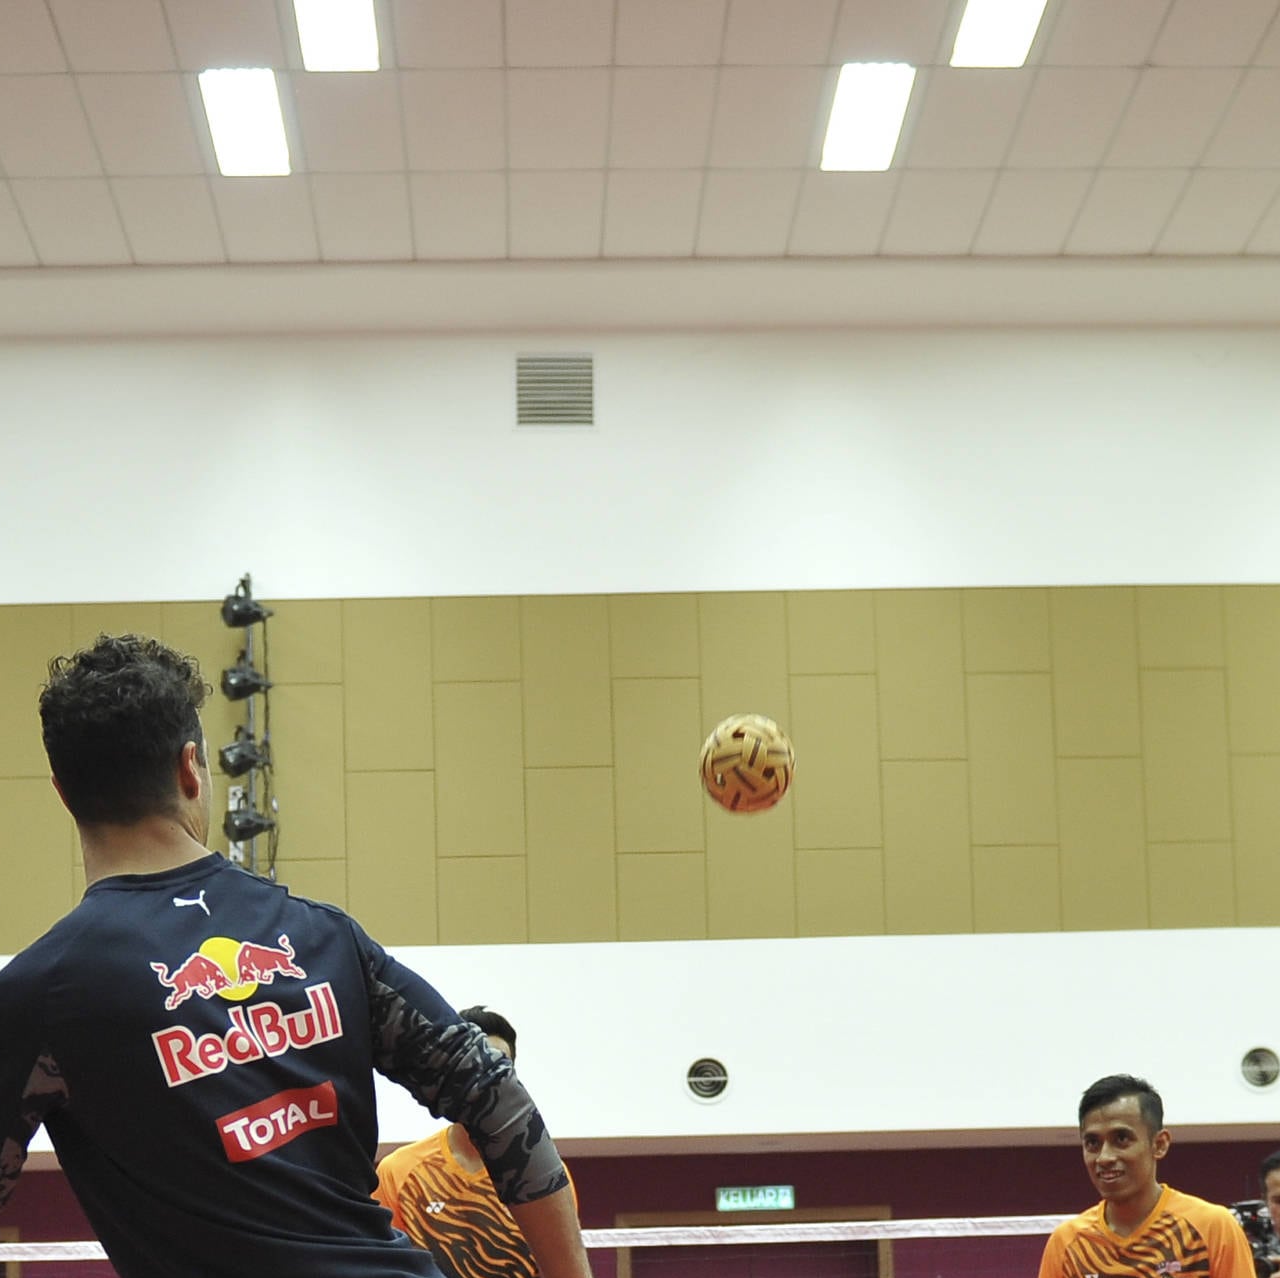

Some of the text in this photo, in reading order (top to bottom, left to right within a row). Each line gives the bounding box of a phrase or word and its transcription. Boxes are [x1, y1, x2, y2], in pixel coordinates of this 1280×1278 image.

[154, 984, 341, 1086] Red Bull
[223, 1100, 334, 1150] TOTAL
